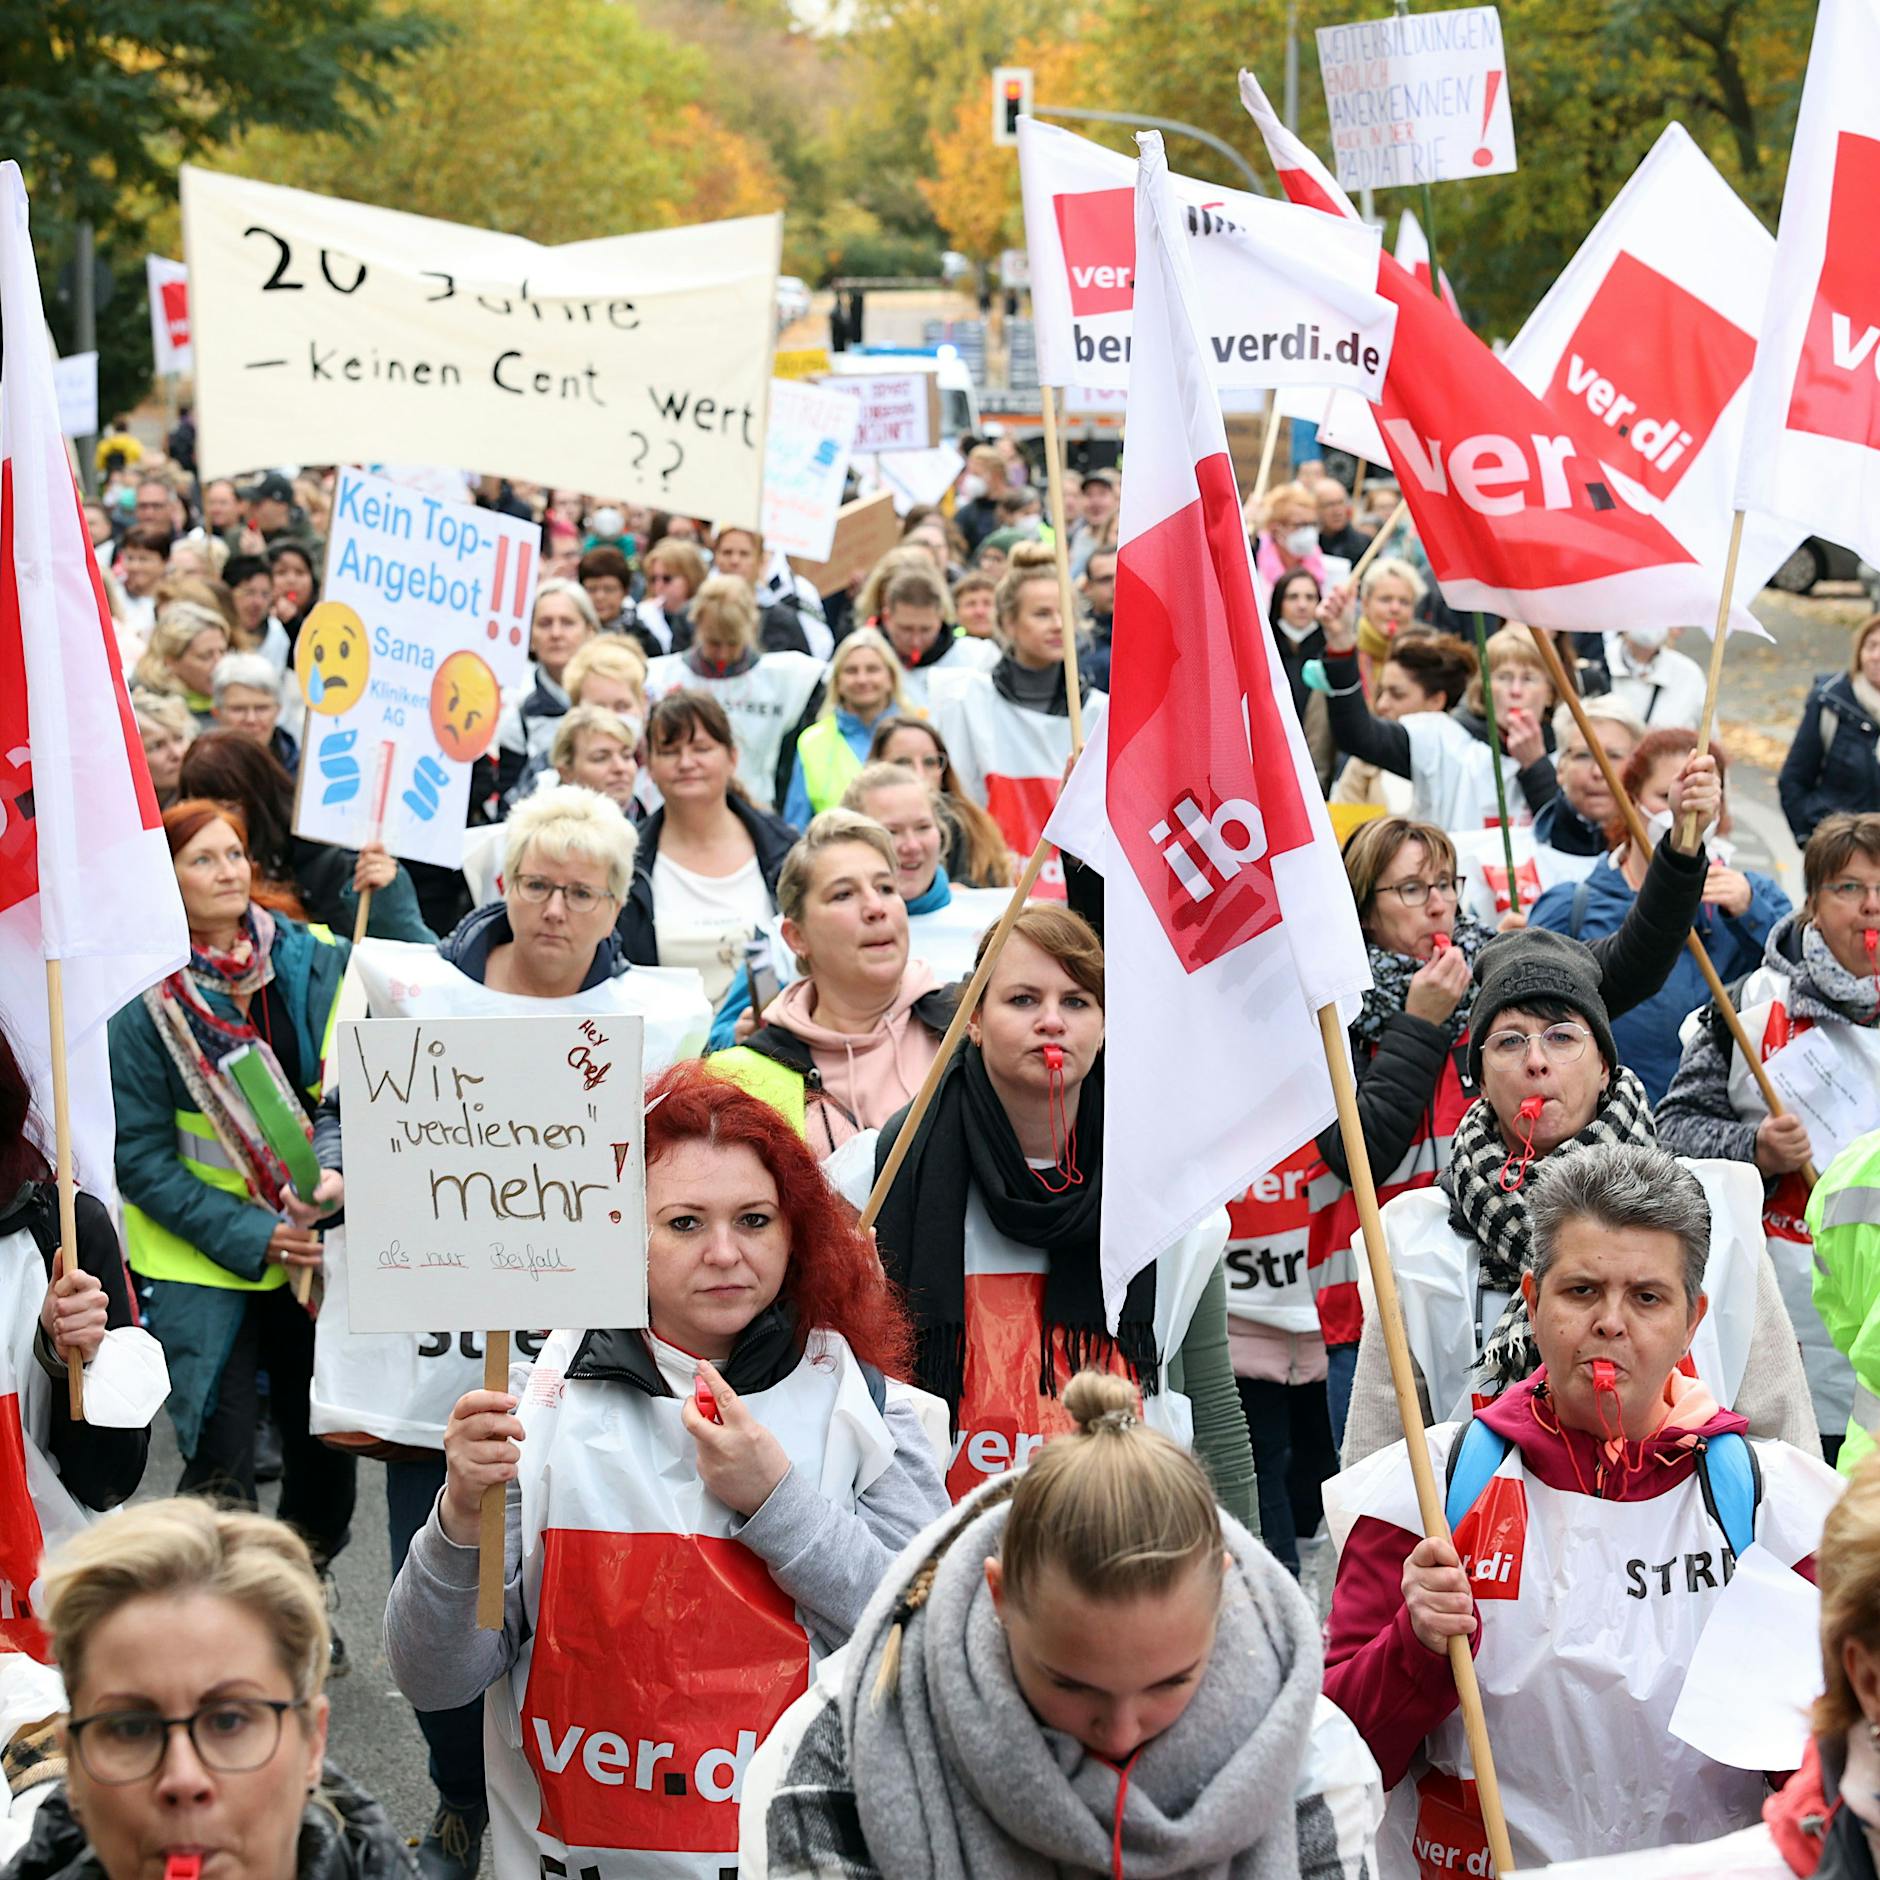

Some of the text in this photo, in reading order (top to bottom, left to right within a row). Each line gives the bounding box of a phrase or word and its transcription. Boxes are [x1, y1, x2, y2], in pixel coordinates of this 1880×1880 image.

[1333, 75, 1473, 126] ANERKENNEN
[310, 341, 461, 387] keinen
[492, 350, 606, 407] Cent
[1211, 323, 1380, 375] verdi.de
[1567, 353, 1693, 472] ver.di
[338, 476, 492, 561] Kein Top-
[337, 537, 482, 617] Angebot
[374, 626, 434, 670] Sana
[370, 679, 429, 708] Kliniken
[382, 706, 405, 727] AG
[578, 1019, 609, 1047] Hey
[354, 1026, 484, 1103] Wir
[568, 1046, 612, 1090] Chef
